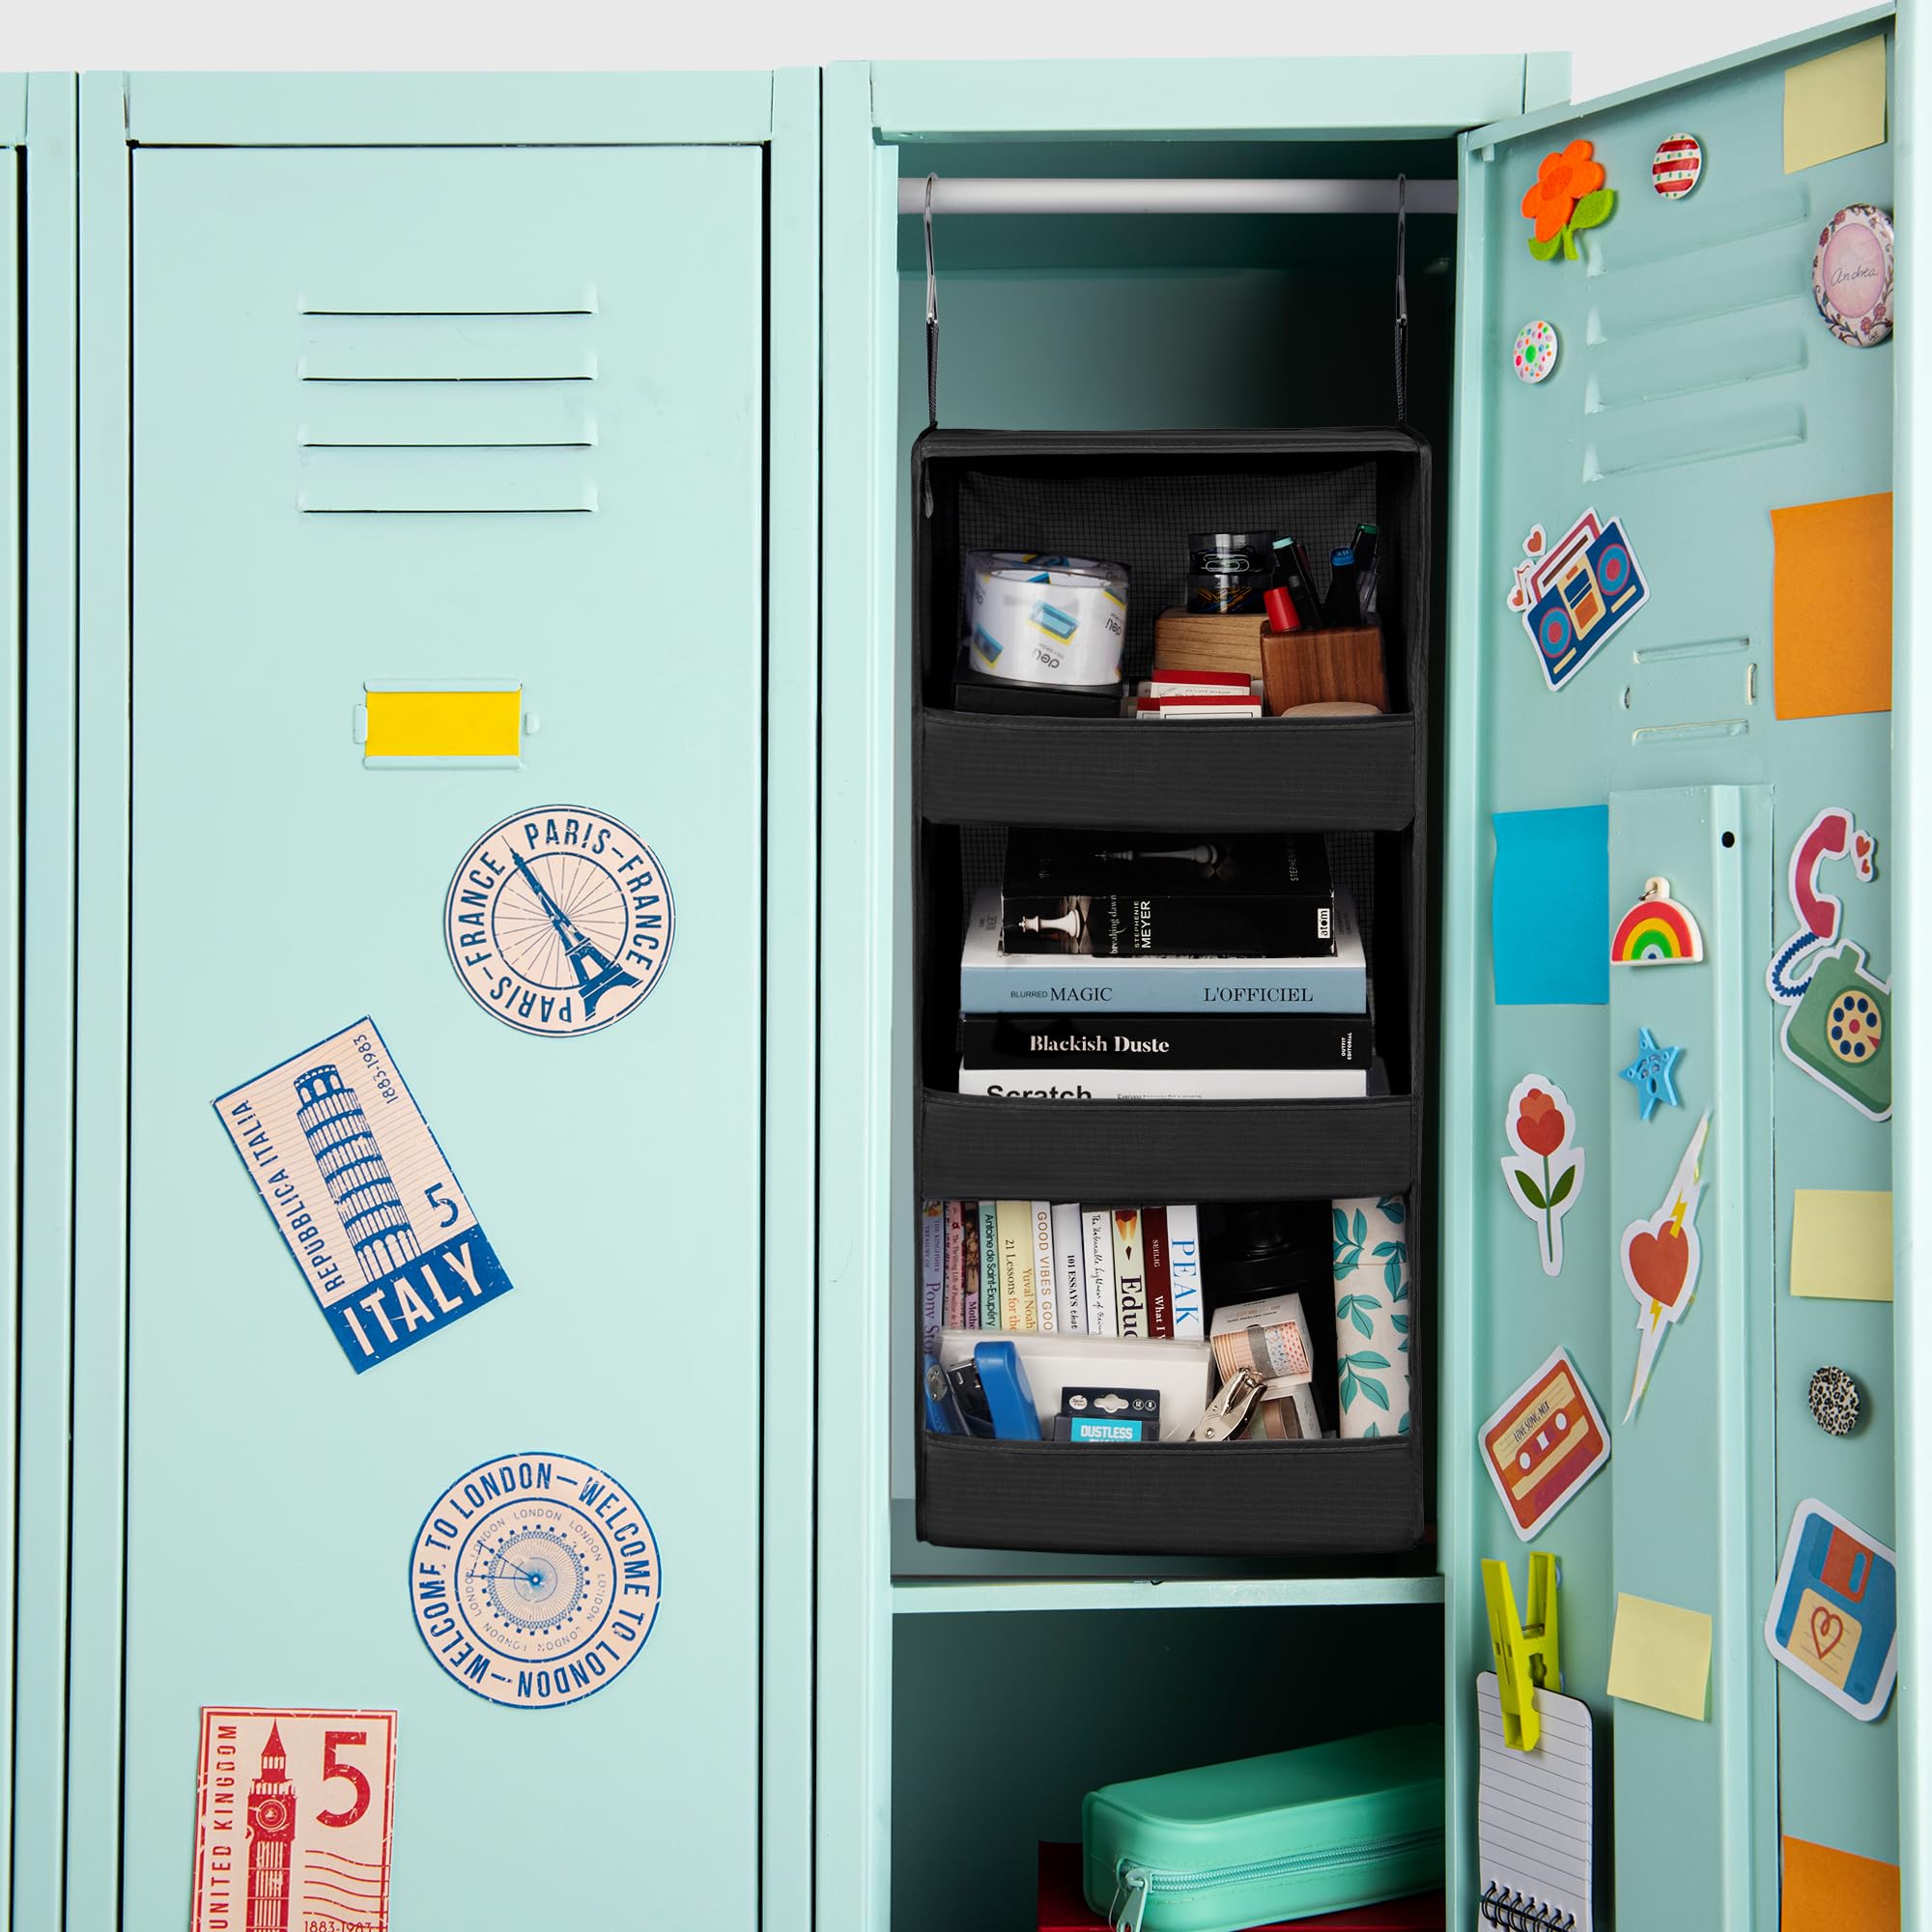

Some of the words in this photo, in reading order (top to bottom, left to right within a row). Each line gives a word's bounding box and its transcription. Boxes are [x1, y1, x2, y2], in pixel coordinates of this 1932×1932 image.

[1832, 265, 1878, 286] Andrea
[1029, 647, 1060, 670] deli
[1108, 895, 1117, 918] dawn
[1109, 919, 1126, 954] breaking
[1141, 900, 1151, 949] MEYER
[1010, 990, 1048, 999] BLURRED
[1050, 987, 1113, 1003] MAGIC
[1204, 987, 1314, 1003] L'OFFICIEL
[1030, 1035, 1108, 1053] Blackish
[1114, 1036, 1170, 1054] Duste
[353, 1034, 398, 1105] 1883-1983
[231, 1099, 279, 1167] ITALIA
[425, 1182, 459, 1229] 5
[1092, 1215, 1101, 1225] The
[268, 1168, 346, 1293] REPUBBLICA
[985, 1213, 995, 1248] Antoine
[1005, 1238, 1014, 1250] 21
[1037, 1211, 1049, 1251] GOOD
[986, 1250, 995, 1263] de
[1066, 1254, 1076, 1268] 101
[1152, 1238, 1161, 1267] SEELIG
[1007, 1254, 1016, 1295] Lessons
[1022, 1267, 1034, 1297] Yuval
[1039, 1256, 1051, 1296] VIBES
[1067, 1271, 1078, 1308] ESSAYS
[1171, 1238, 1200, 1325] PEAK
[344, 1242, 483, 1356] ITALY
[985, 1263, 997, 1327] Saint-Exupéry
[1009, 1297, 1018, 1313] for
[1154, 1294, 1165, 1323] What
[1024, 1299, 1036, 1329] Noah
[1041, 1301, 1053, 1331] GOO
[1070, 1310, 1079, 1330] that
[1080, 1425, 1133, 1439] DUSTLESS
[1513, 1424, 1527, 1442] LOVE
[1524, 1412, 1541, 1431] SONG
[1538, 1400, 1550, 1417] MIX
[425, 1518, 459, 1551] TO
[448, 1463, 553, 1520] LONDON
[513, 1508, 562, 1520] LONDON
[568, 1520, 603, 1562] LONDON
[578, 1476, 651, 1598] WELCOME
[611, 1609, 645, 1642] TO
[518, 1640, 620, 1698] LONDON
[213, 1725, 238, 1832] KINGDOM
[316, 1731, 371, 1828] 5
[209, 1845, 232, 1929] UNITED
